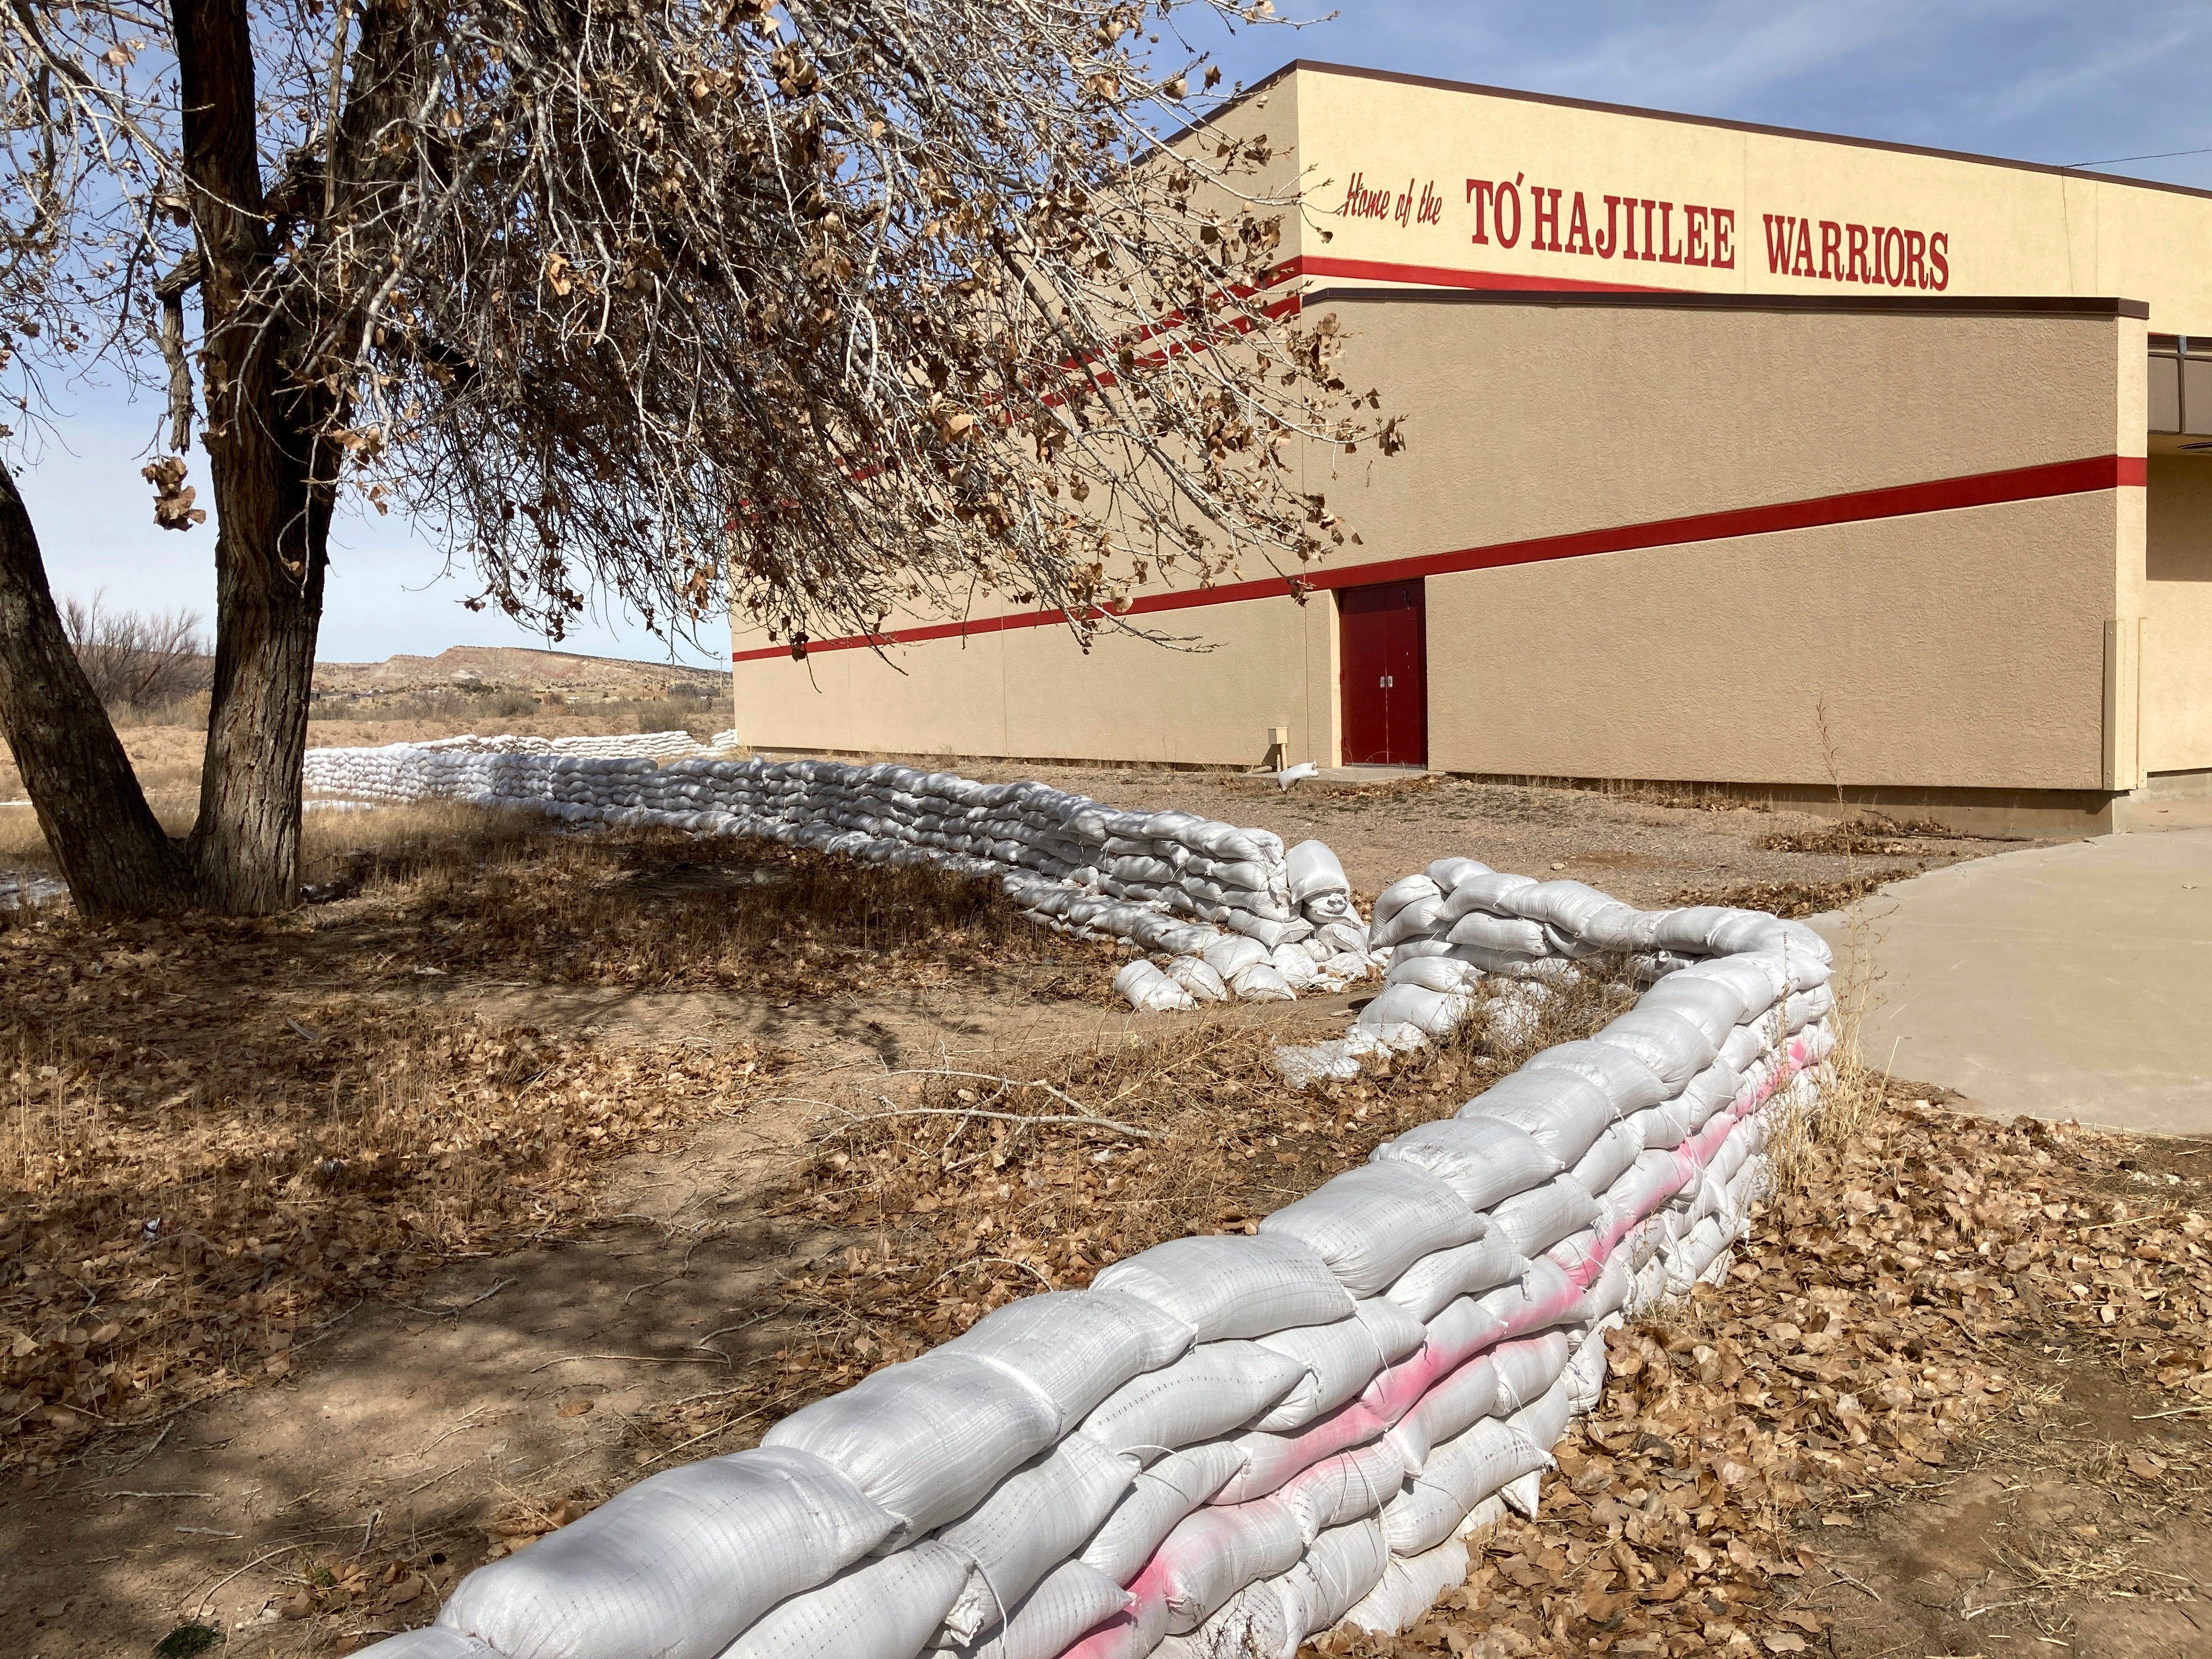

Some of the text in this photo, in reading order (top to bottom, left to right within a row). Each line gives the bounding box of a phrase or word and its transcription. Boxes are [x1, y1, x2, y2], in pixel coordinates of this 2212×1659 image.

[1343, 172, 1390, 220] Home
[1395, 178, 1415, 228] of
[1417, 180, 1442, 225] the
[1763, 214, 1949, 291] WARRIORS
